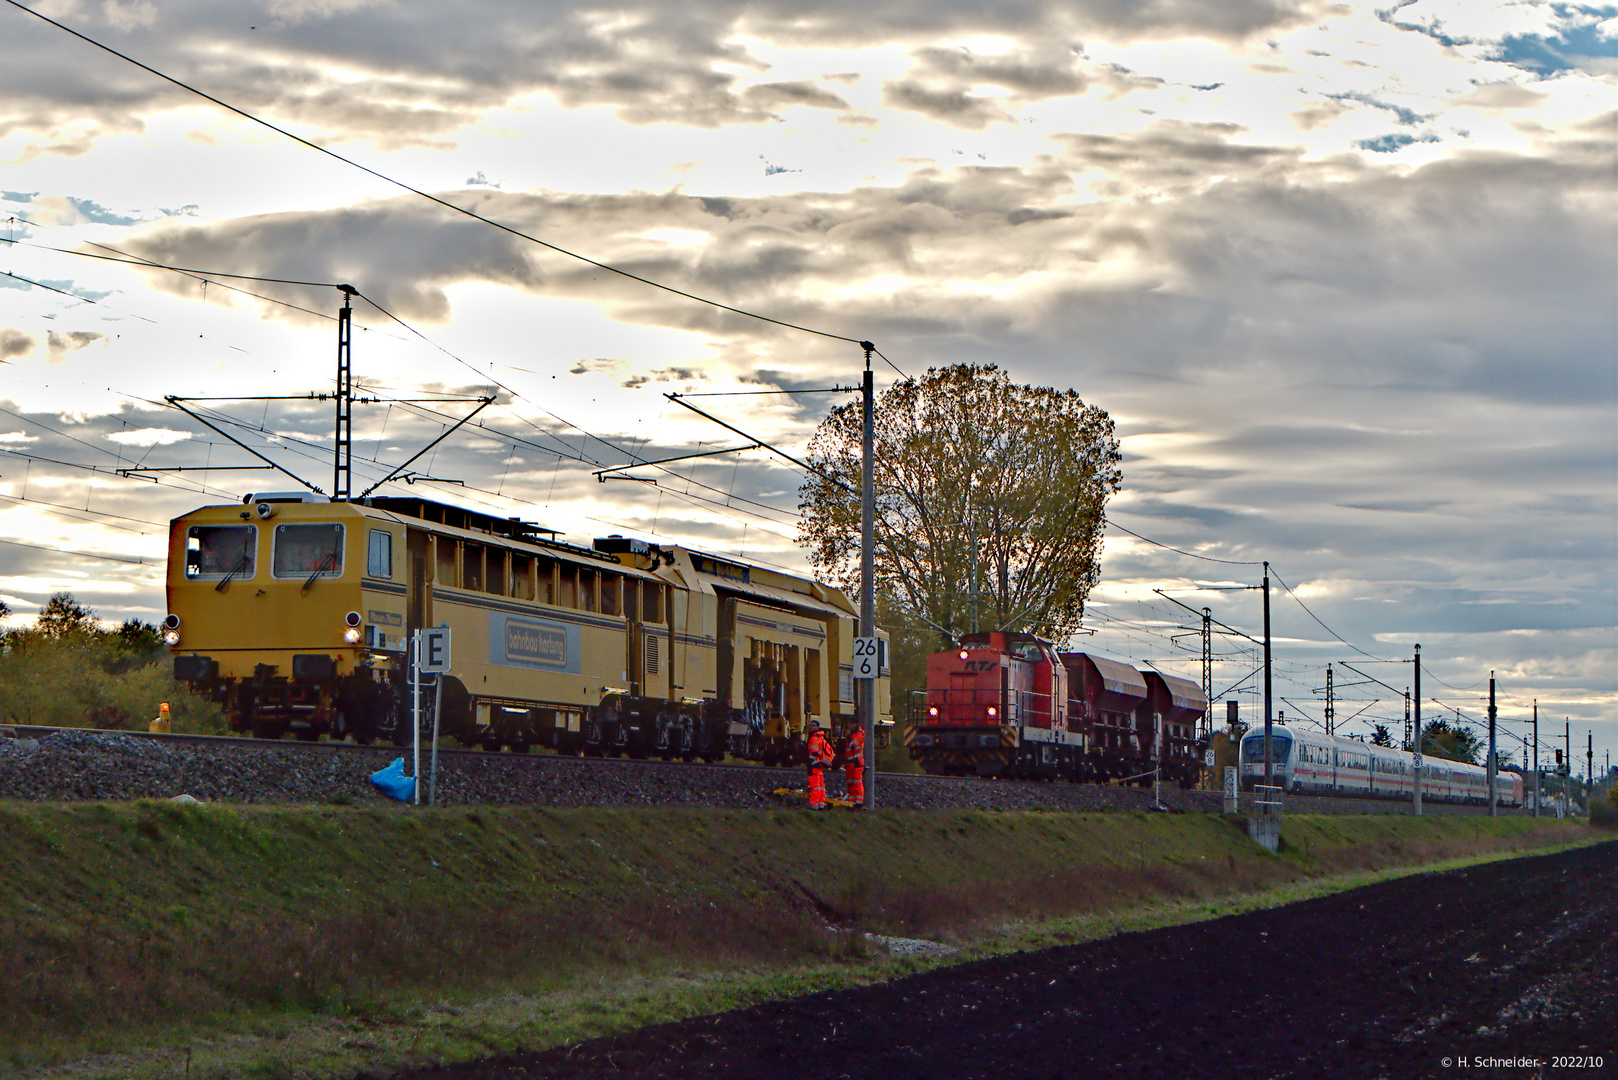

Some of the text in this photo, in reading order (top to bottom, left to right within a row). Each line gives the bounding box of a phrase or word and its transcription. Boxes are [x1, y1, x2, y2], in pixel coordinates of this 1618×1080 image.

[429, 634, 442, 665] E
[855, 639, 876, 656] 26
[860, 657, 871, 675] 6
[964, 661, 998, 671] RTS
